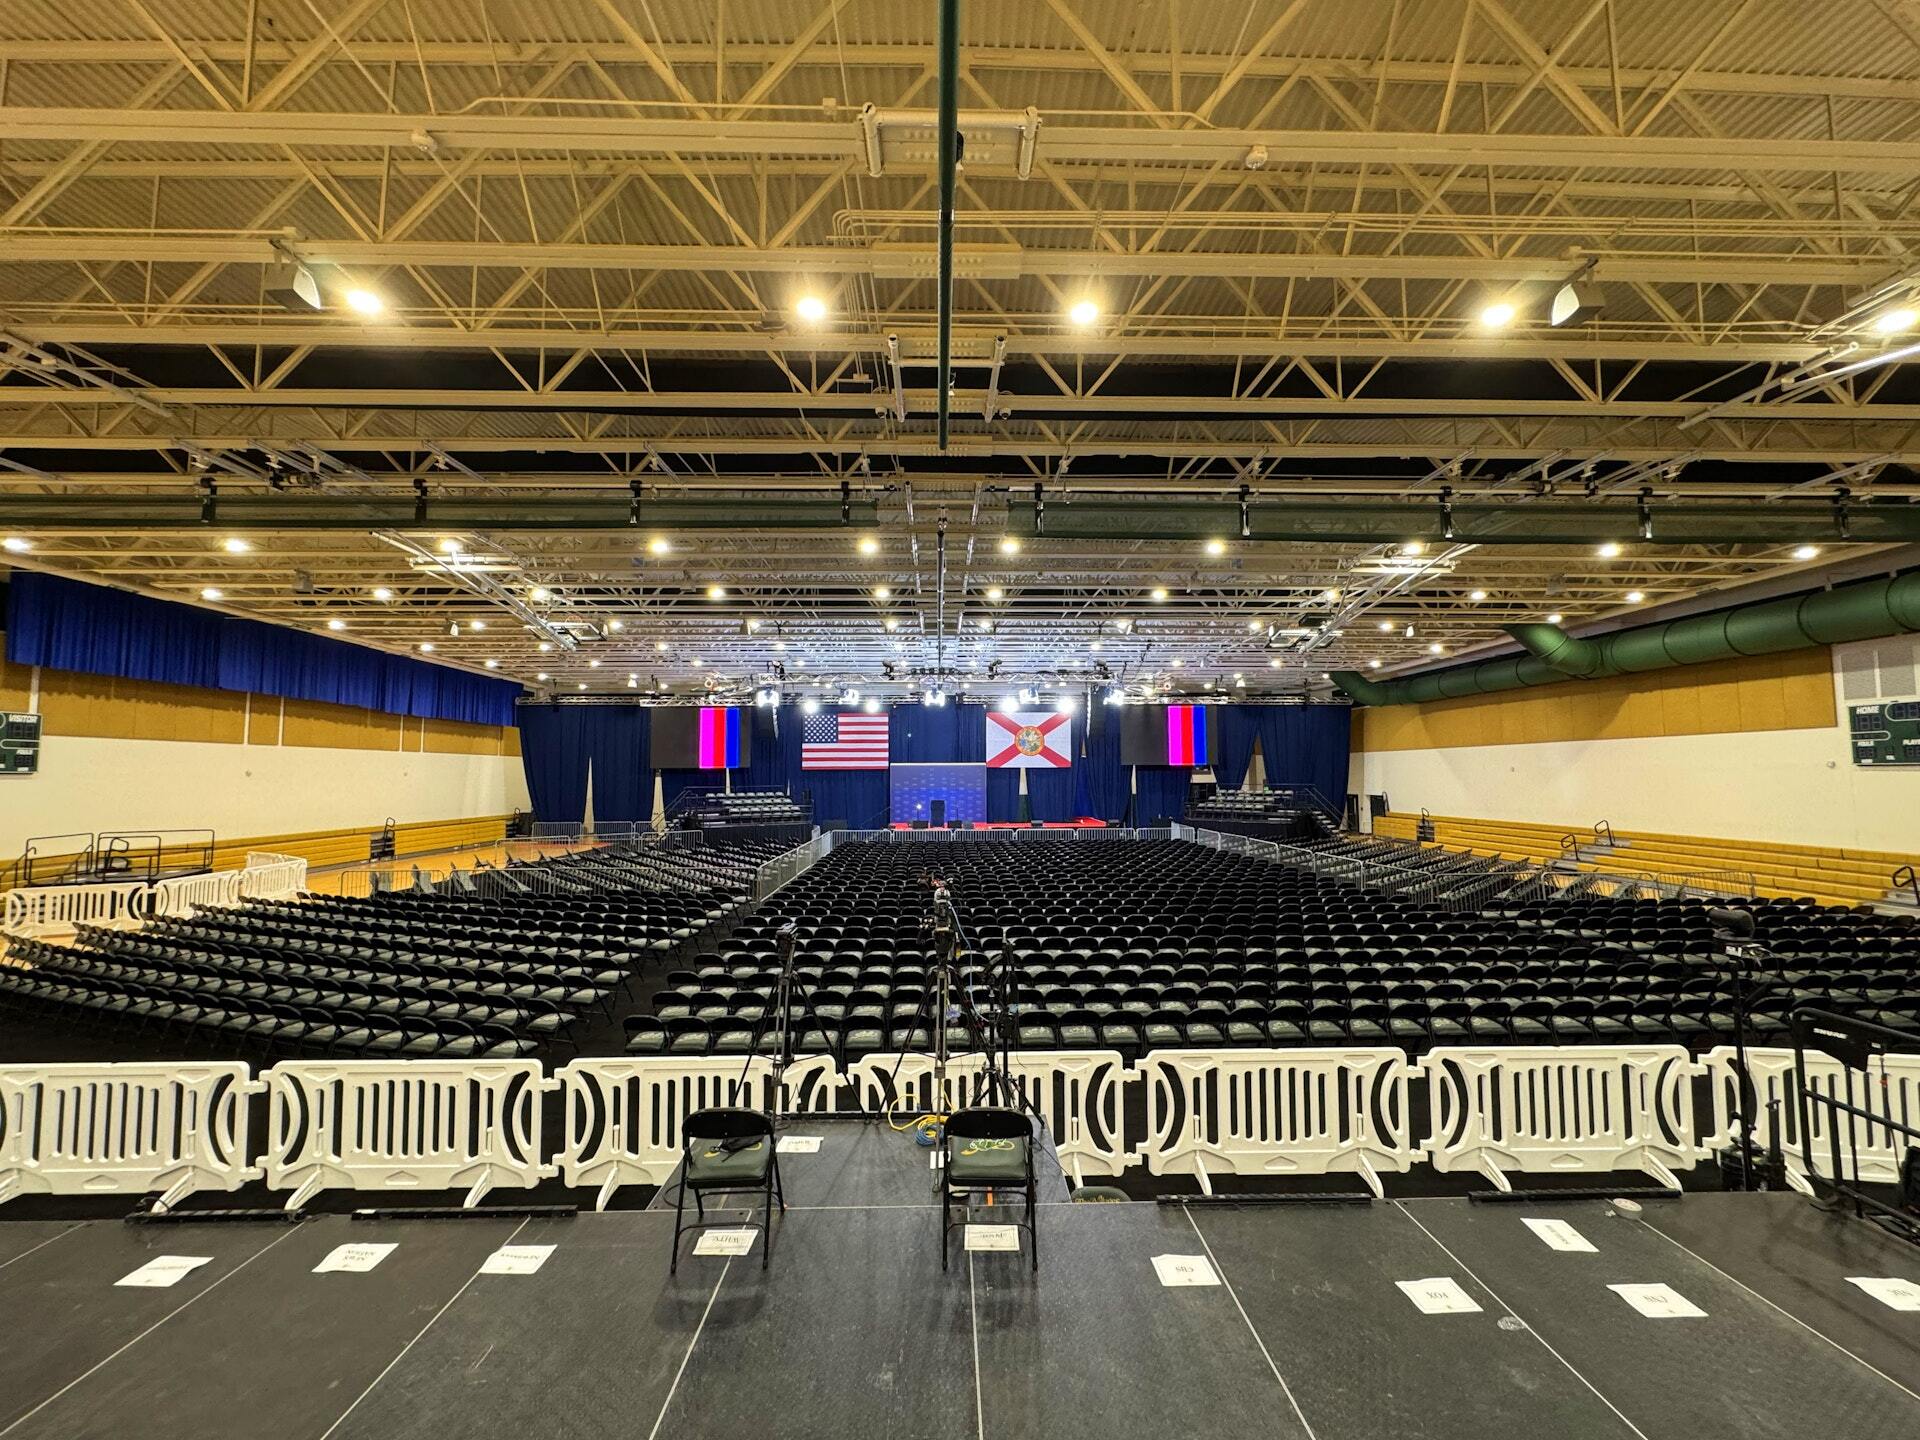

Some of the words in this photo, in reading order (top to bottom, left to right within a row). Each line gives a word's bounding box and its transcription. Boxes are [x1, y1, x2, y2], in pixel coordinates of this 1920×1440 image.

[1856, 705, 1880, 715] HOME
[9, 714, 38, 724] VISITOR
[1813, 1028, 1848, 1039] SHURE
[1176, 1265, 1194, 1273] CBS
